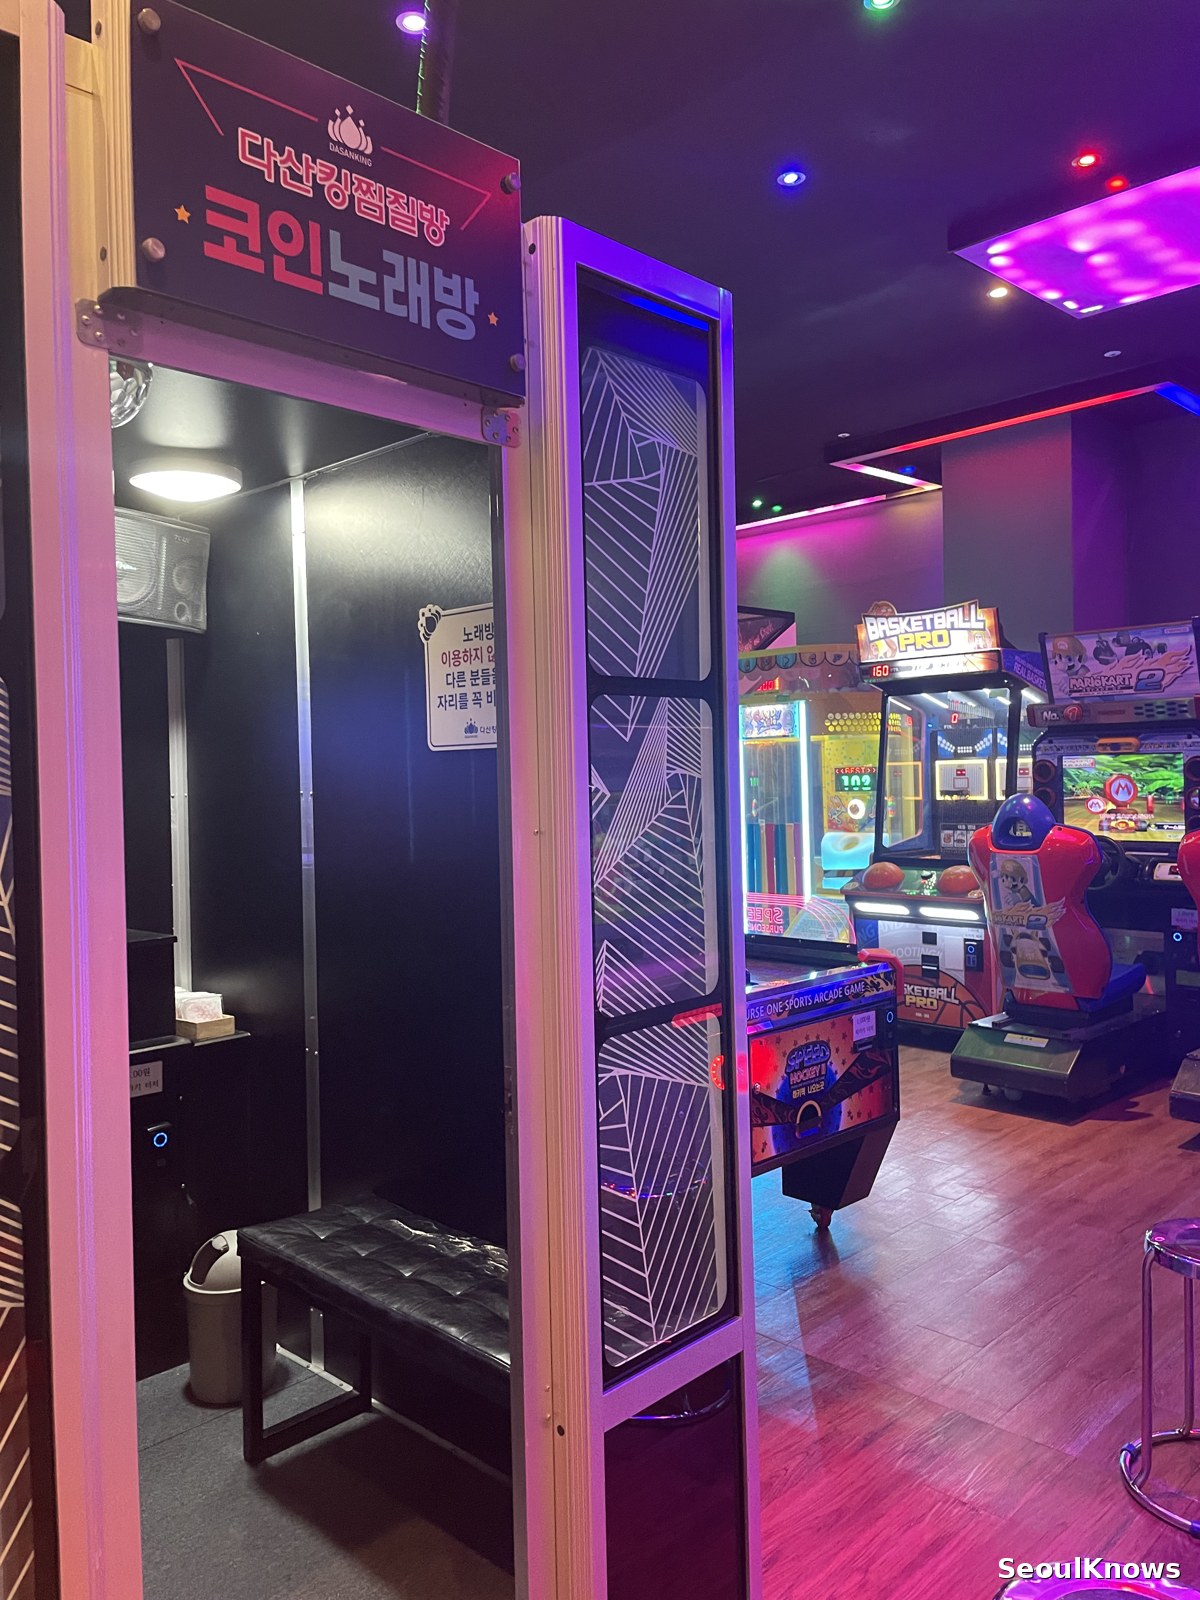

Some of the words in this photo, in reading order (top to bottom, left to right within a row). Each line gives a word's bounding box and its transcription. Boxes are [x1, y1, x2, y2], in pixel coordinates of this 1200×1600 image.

[329, 142, 372, 167] DASANKING
[237, 127, 450, 247] 다산킹찜질방
[203, 185, 480, 341] 코인노래방
[865, 604, 985, 642] BASKETBALL
[899, 630, 951, 652] PRO
[441, 646, 483, 668] 이용하지
[446, 671, 467, 689] 다른
[872, 665, 889, 678] 160
[1134, 669, 1166, 694] 2
[437, 692, 469, 711] 자리를
[472, 691, 483, 709] 꼭
[1043, 711, 1060, 721] No.
[766, 1001, 783, 1016] ONE
[785, 995, 812, 1011] SPORTS
[814, 988, 843, 1004] ARCADE
[844, 981, 866, 996] GAME
[903, 984, 959, 1005] SKETBALL
[906, 995, 938, 1010] PRO
[786, 1044, 830, 1073] SPEED
[130, 1067, 151, 1078] 00원
[789, 1064, 821, 1085] HOCKEY
